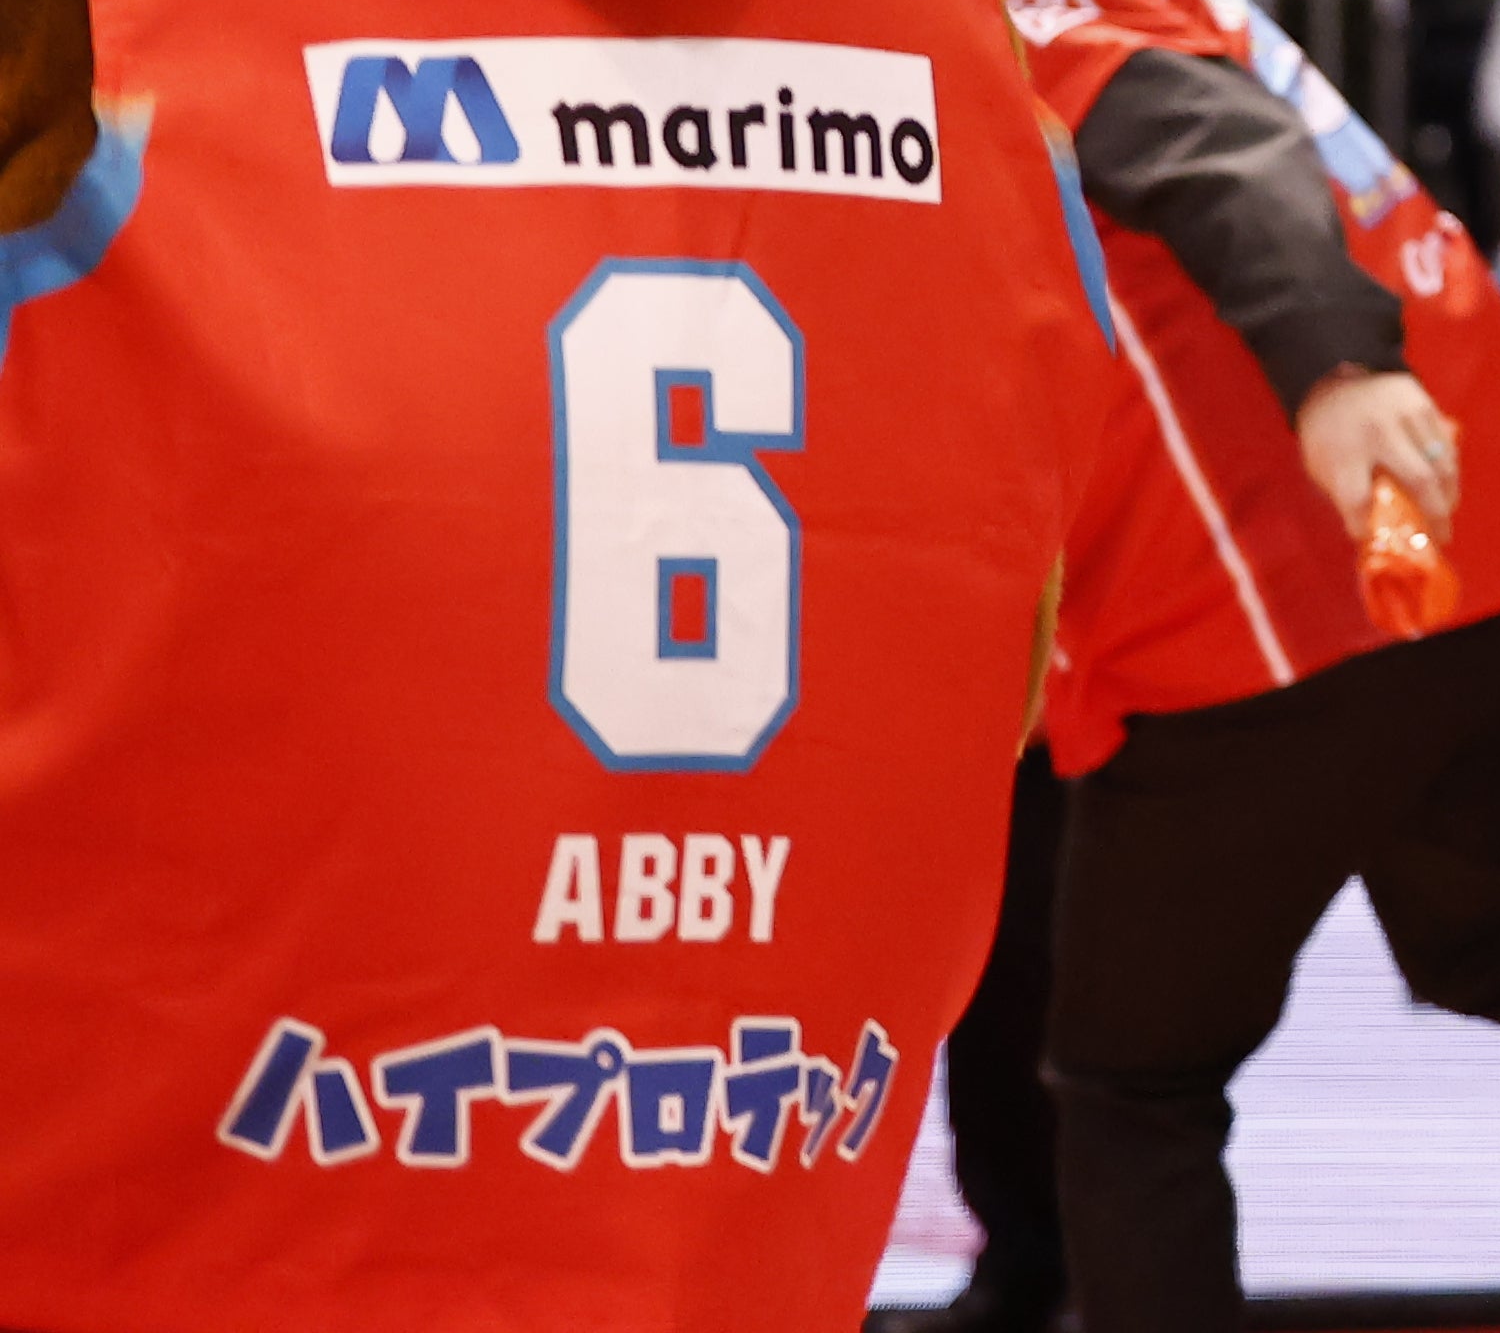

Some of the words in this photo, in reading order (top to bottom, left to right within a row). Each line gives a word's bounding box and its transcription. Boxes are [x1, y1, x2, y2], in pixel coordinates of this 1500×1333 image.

[551, 85, 934, 185] marimo
[546, 256, 805, 774] 6
[532, 833, 791, 944] ABBY
[217, 1015, 900, 1175] ハイプロテック
